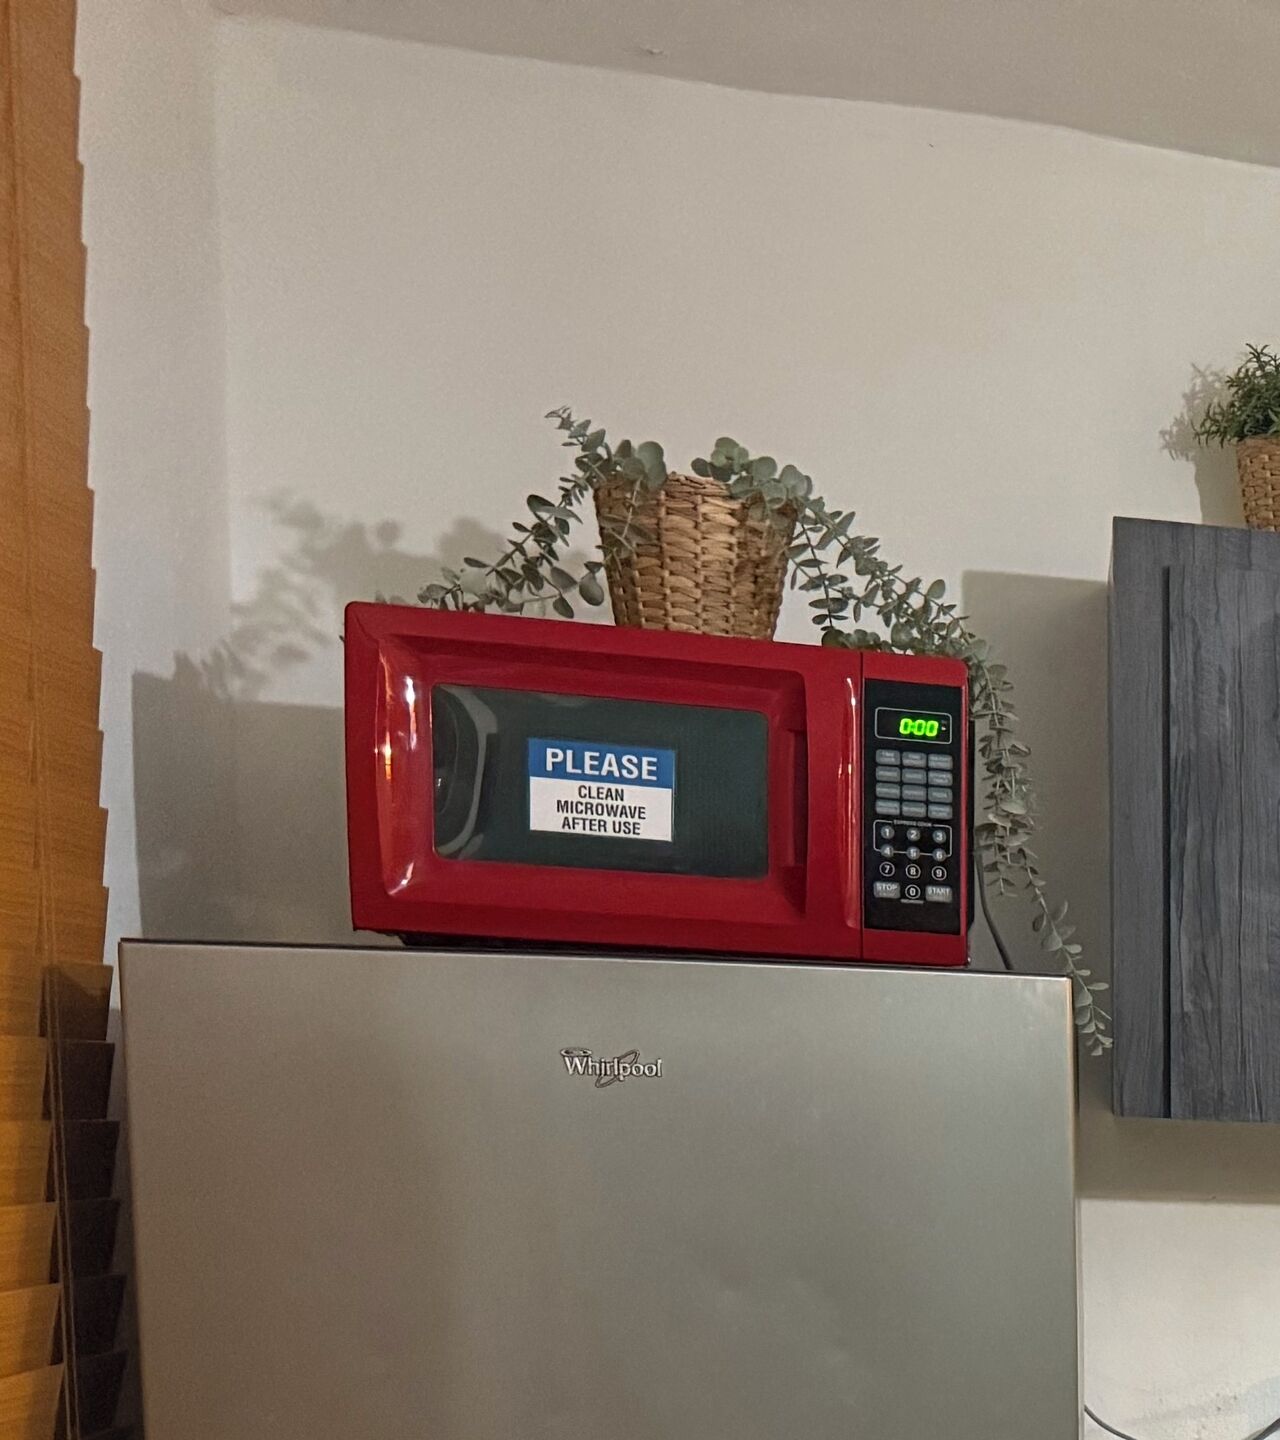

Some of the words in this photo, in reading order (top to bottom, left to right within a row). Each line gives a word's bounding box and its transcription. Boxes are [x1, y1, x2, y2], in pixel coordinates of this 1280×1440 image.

[545, 747, 658, 781] PLEASE
[578, 785, 624, 802] CLEAN
[556, 800, 646, 820] MICROWAVE
[562, 816, 607, 833] AFTER
[612, 820, 641, 836] USE
[876, 883, 898, 891] STOP
[928, 887, 951, 895] START
[562, 1055, 663, 1082] Whirlpool
